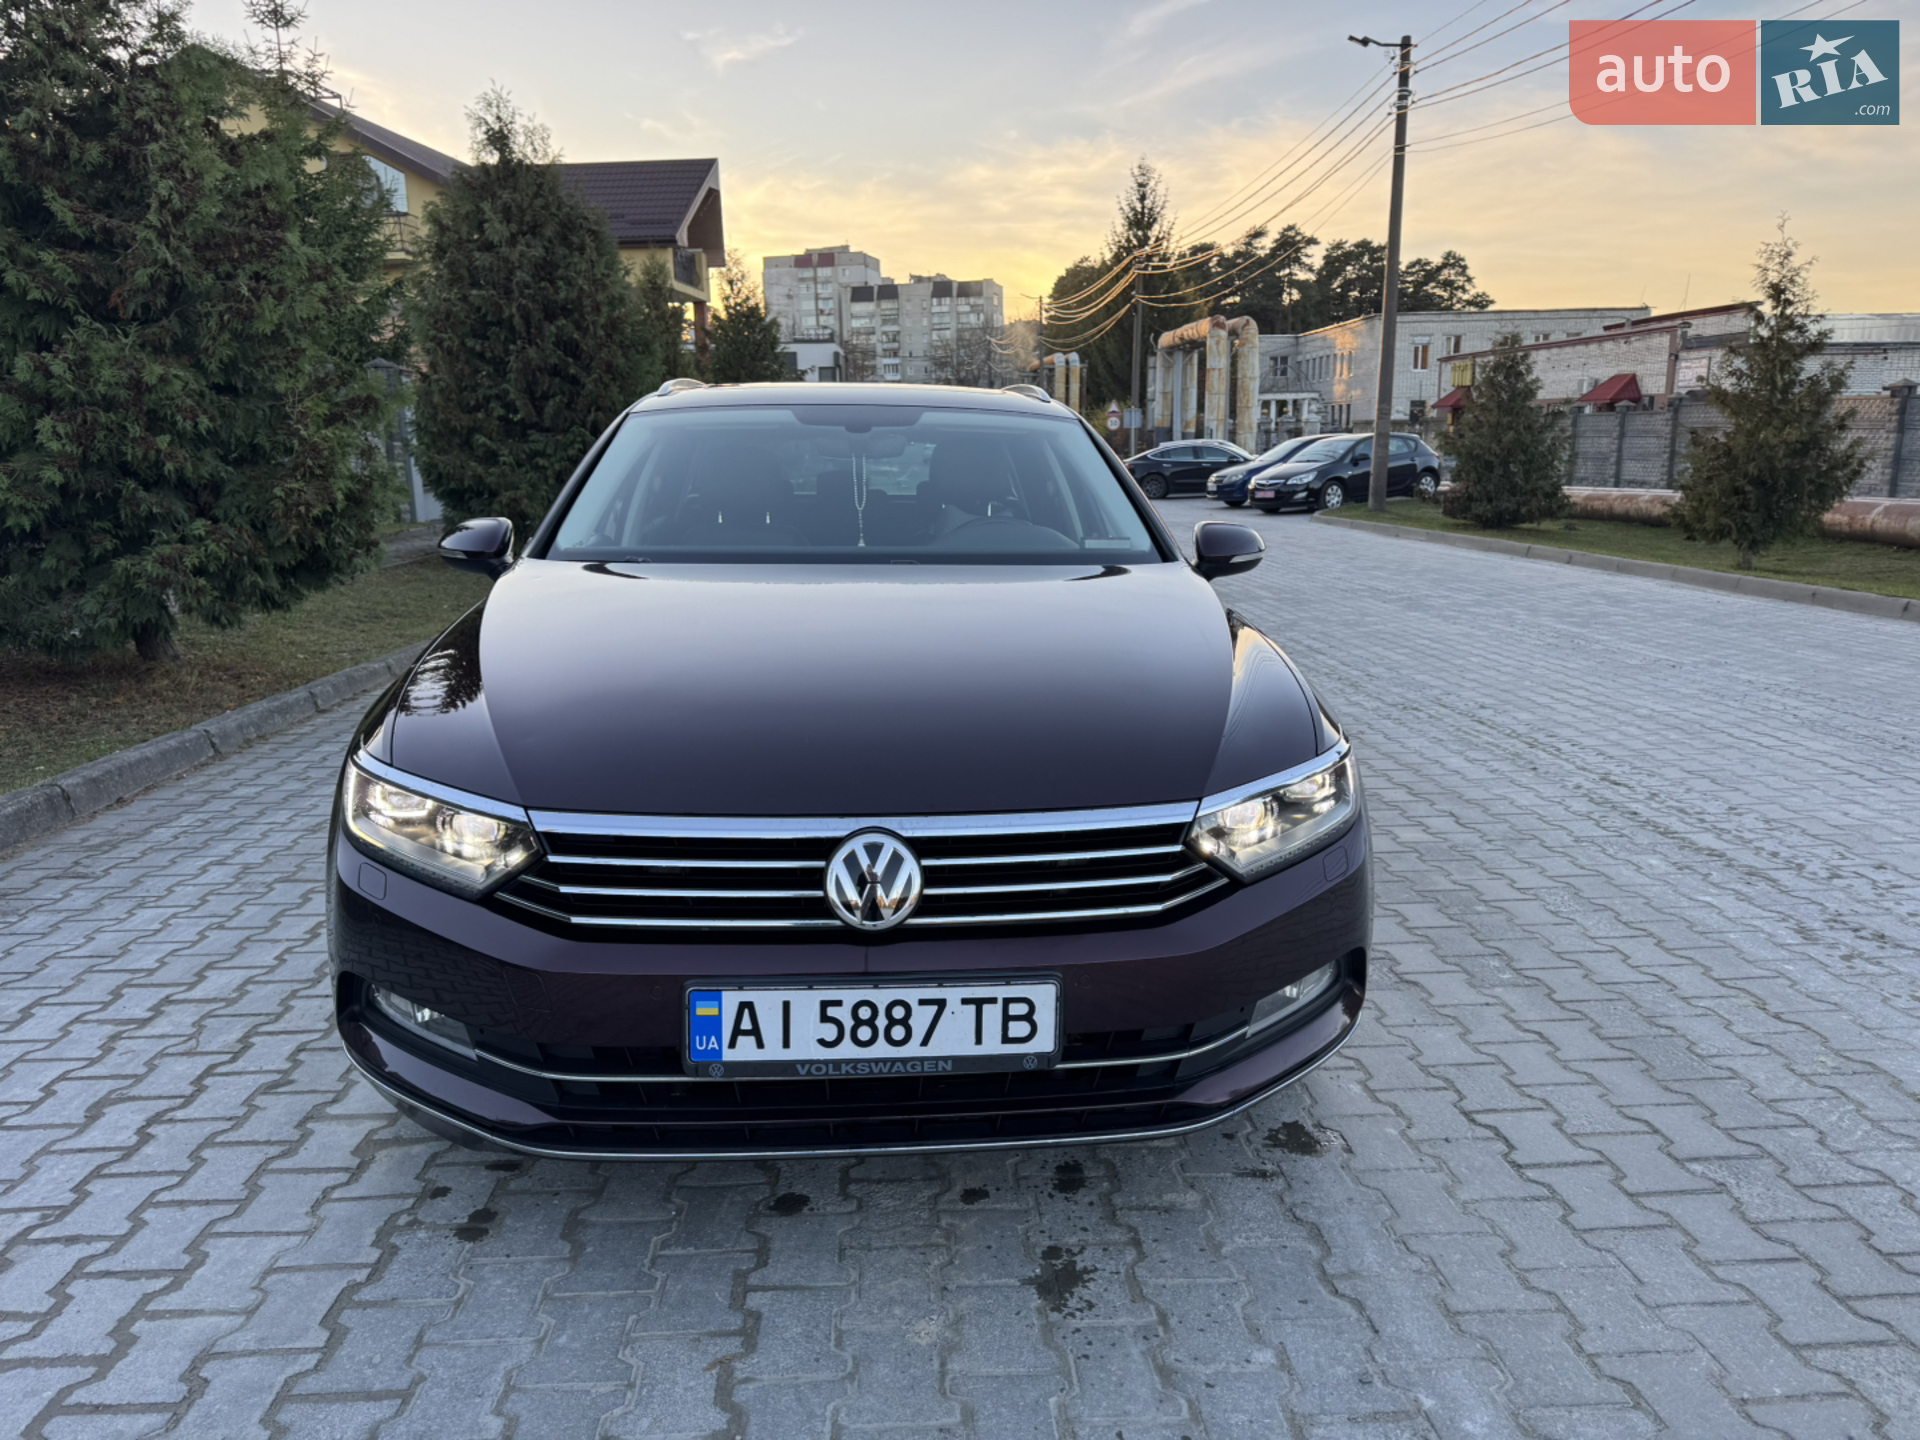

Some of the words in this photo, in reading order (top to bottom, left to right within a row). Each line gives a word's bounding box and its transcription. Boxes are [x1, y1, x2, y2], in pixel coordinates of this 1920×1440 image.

[727, 1000, 791, 1050] AI
[815, 998, 947, 1049] 5887
[960, 996, 1038, 1046] TB
[695, 1035, 720, 1051] UA
[795, 1059, 953, 1076] VOLKSWAGEN
